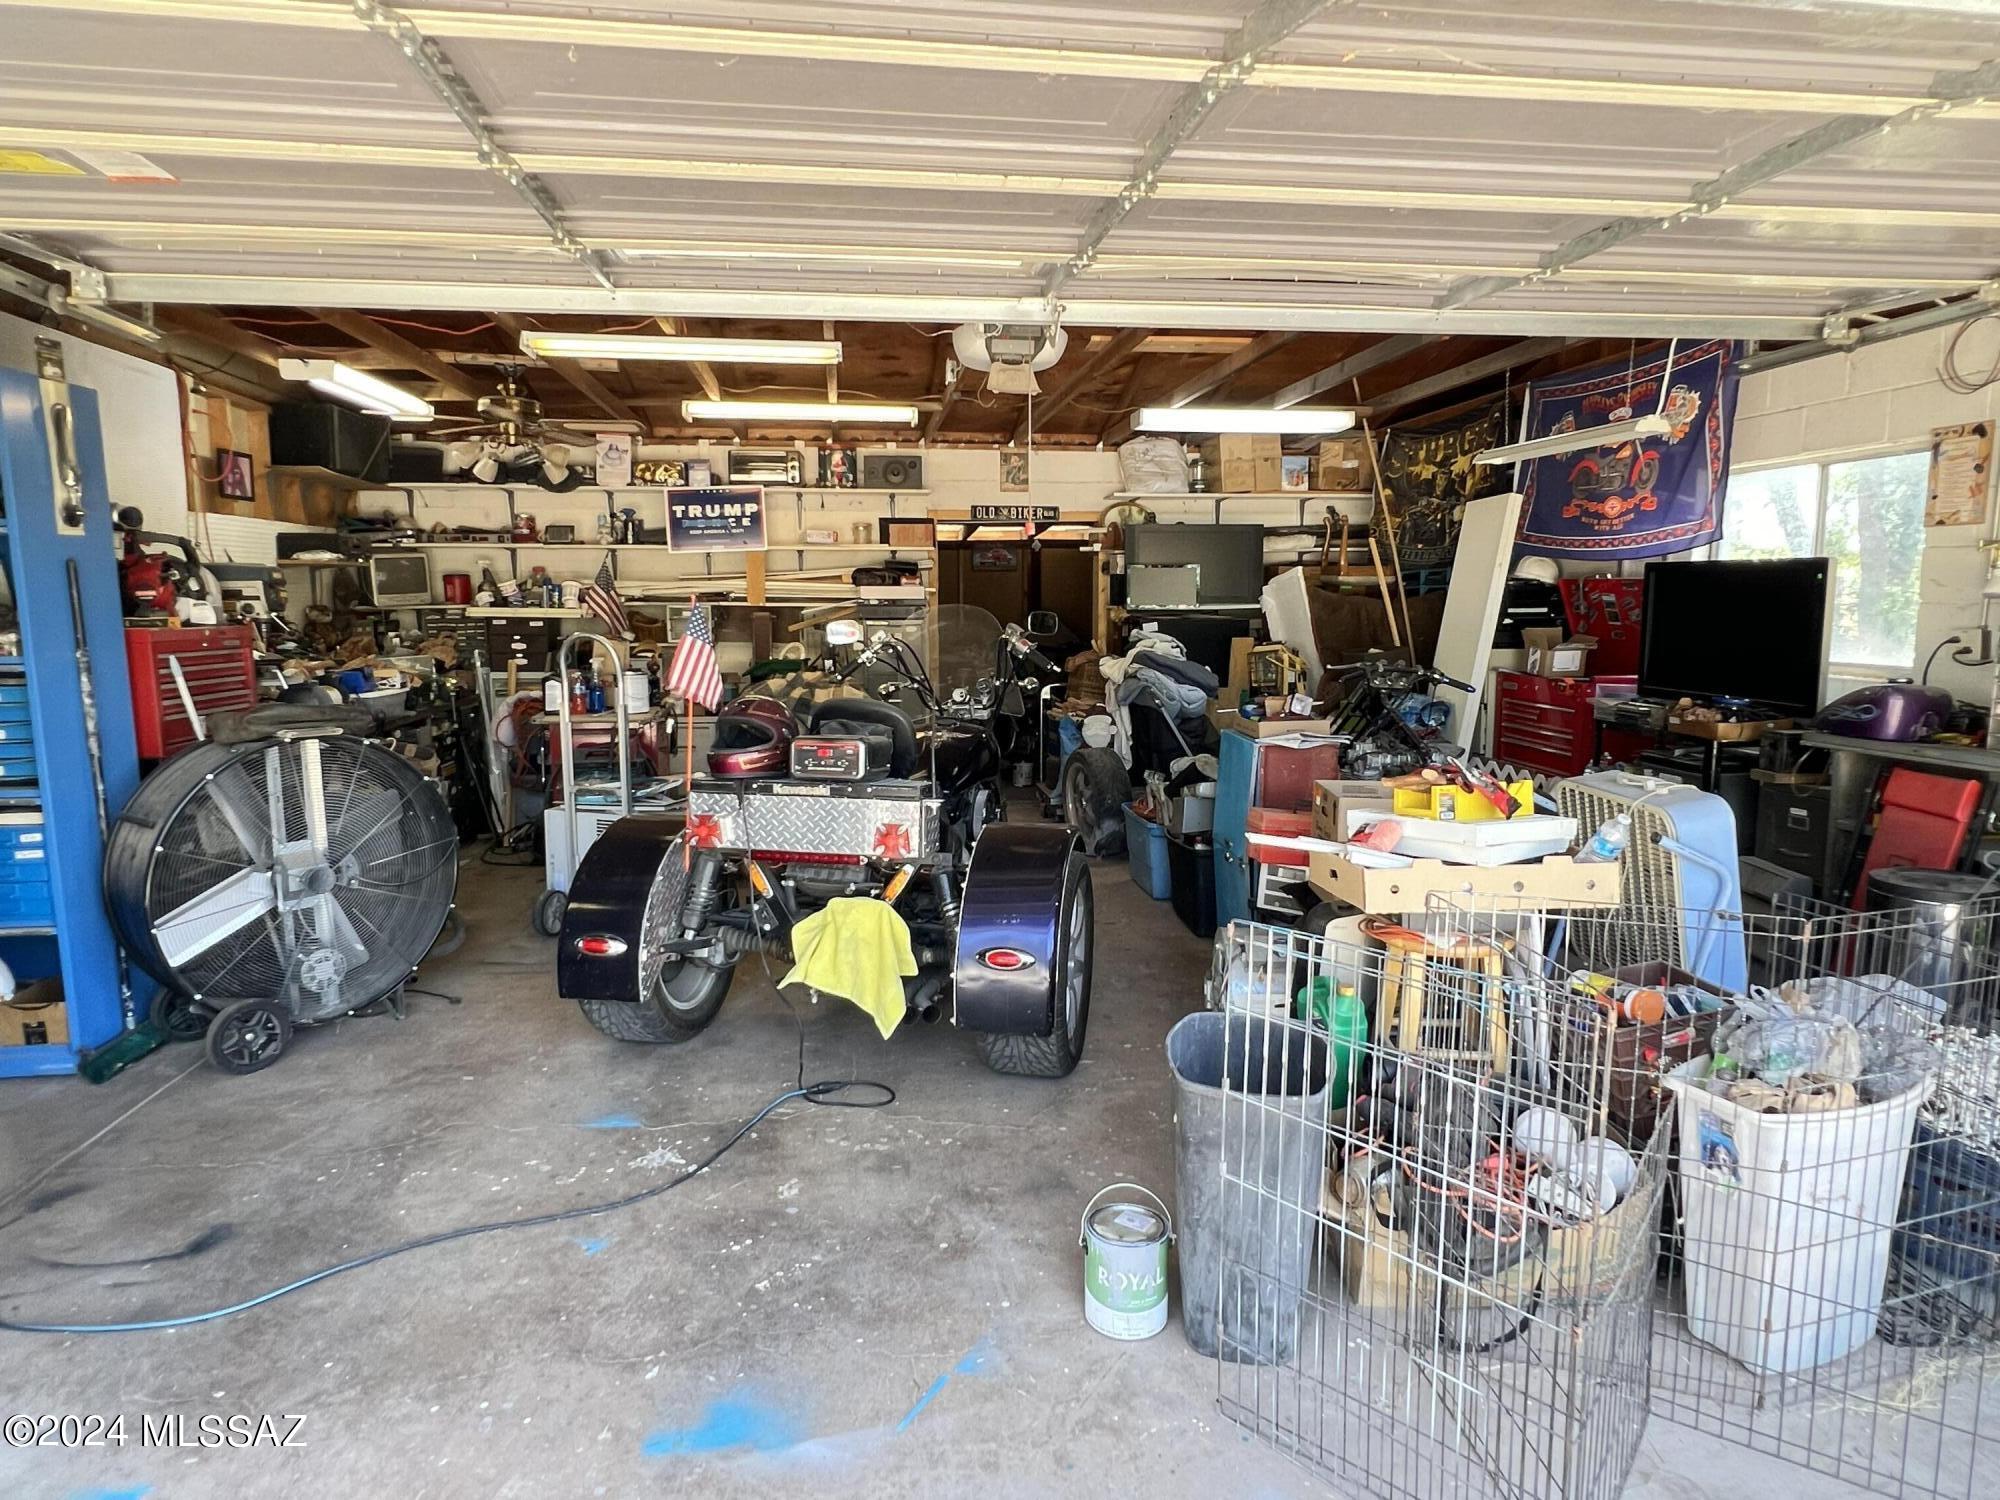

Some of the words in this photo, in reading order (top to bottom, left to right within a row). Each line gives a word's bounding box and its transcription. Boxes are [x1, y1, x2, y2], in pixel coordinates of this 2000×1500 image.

[672, 503, 758, 518] TRUMP
[976, 506, 995, 519] OLD
[1010, 506, 1043, 519] BIKER
[1098, 1265, 1164, 1291] ROYAL
